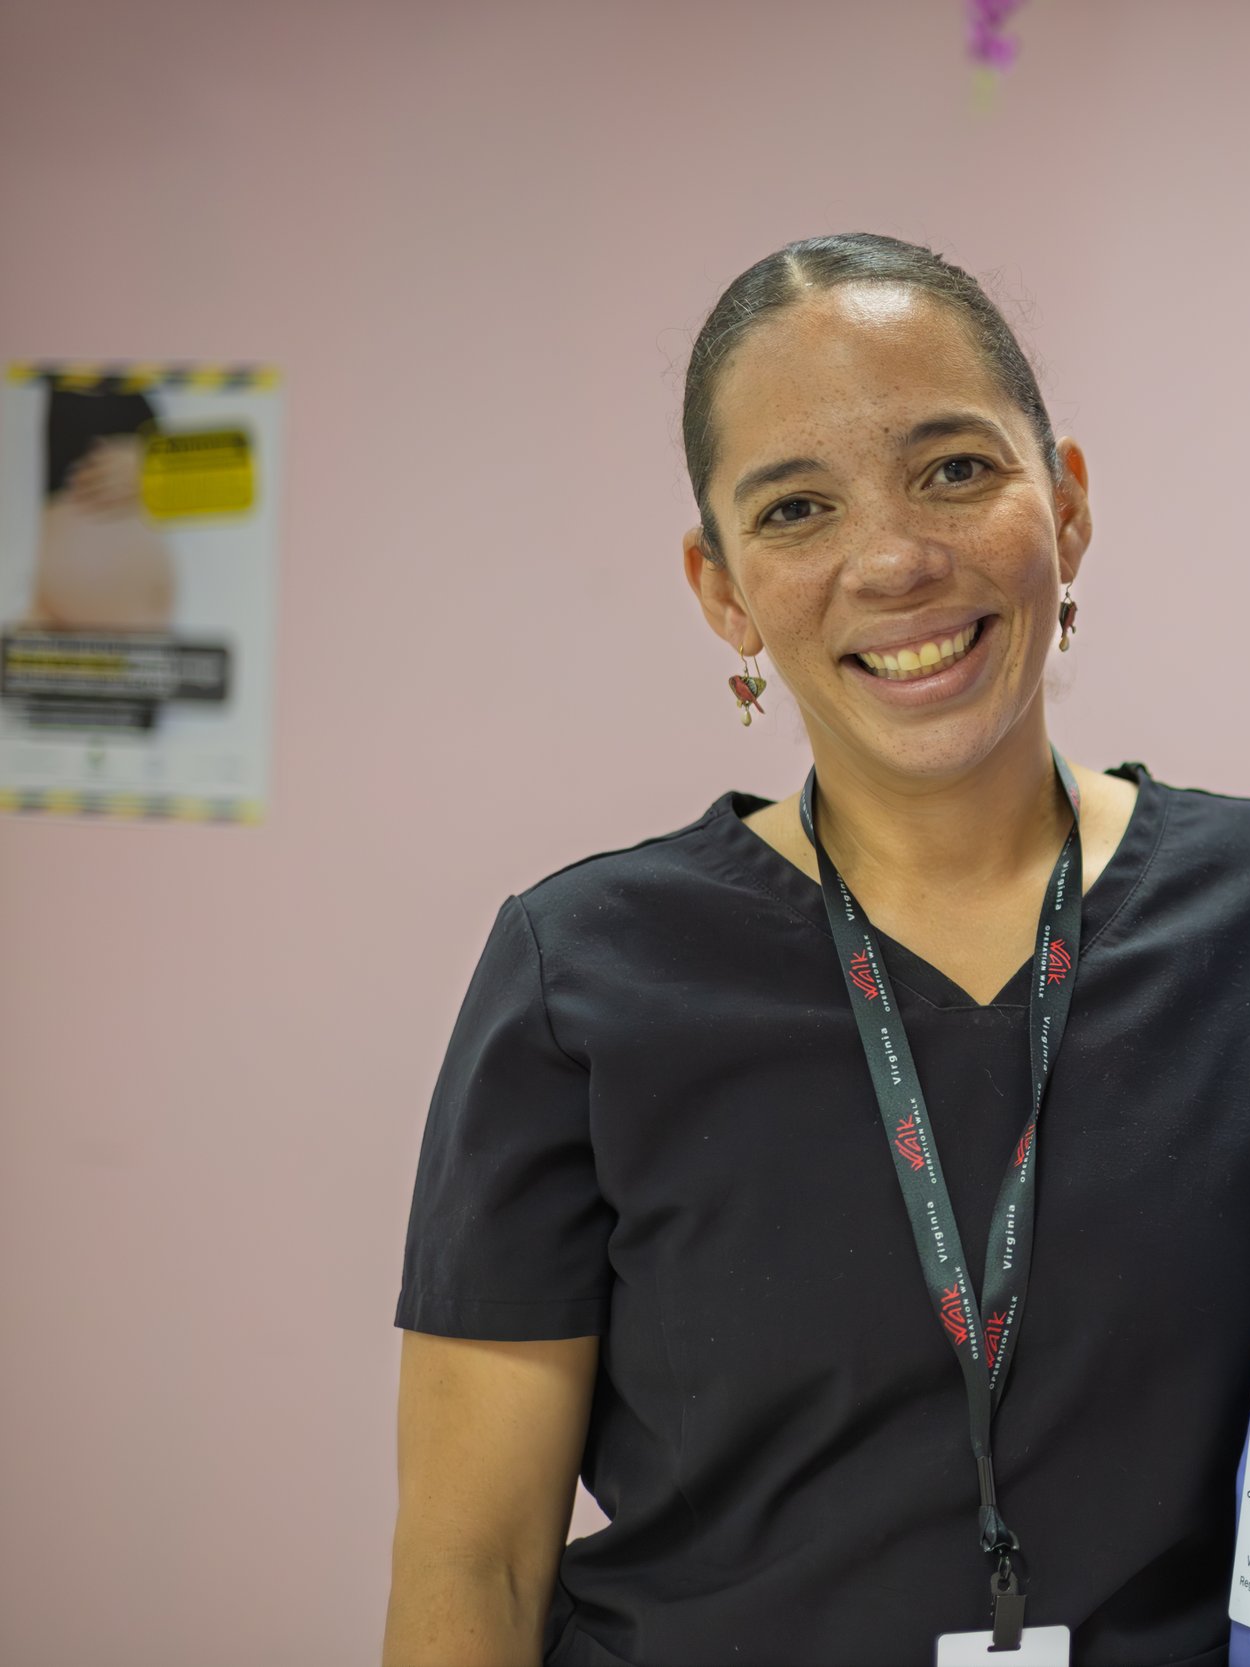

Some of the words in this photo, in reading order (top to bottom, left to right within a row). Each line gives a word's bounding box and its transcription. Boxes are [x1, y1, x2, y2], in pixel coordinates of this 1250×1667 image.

[864, 935, 874, 959] WALK
[1040, 925, 1051, 971] OPERATION
[872, 962, 891, 1012] OPERATION
[881, 1028, 901, 1085] Virginia
[910, 1098, 921, 1124] WALK
[919, 1128, 937, 1184] OPERATION
[927, 1201, 948, 1262] Virginia
[1002, 1204, 1016, 1269] Virginia
[955, 1266, 966, 1293] WALK
[963, 1298, 978, 1360] OPERATION
[990, 1330, 1009, 1390] OPERATION
[1006, 1296, 1018, 1324] WALK
